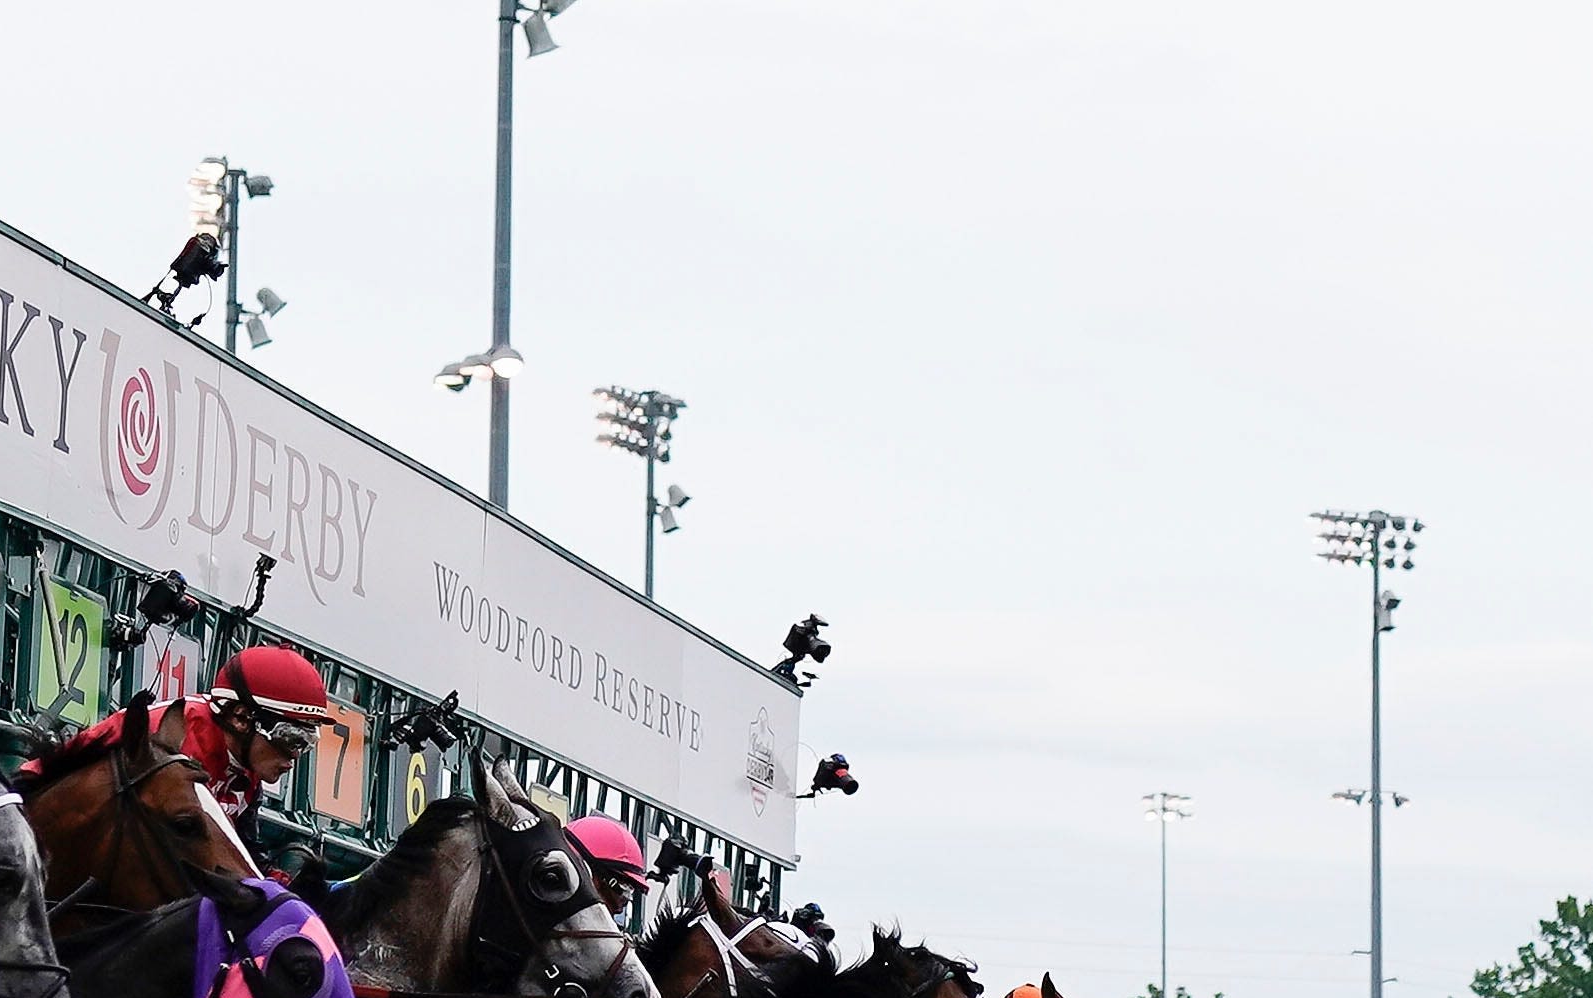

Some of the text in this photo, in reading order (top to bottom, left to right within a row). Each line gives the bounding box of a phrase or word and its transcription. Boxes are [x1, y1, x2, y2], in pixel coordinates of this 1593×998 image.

[186, 375, 378, 607] DERBY
[58, 608, 88, 706] 12
[433, 560, 702, 753] WOODFORD RESERVE
[332, 723, 350, 800] 7
[407, 751, 428, 826] 6
